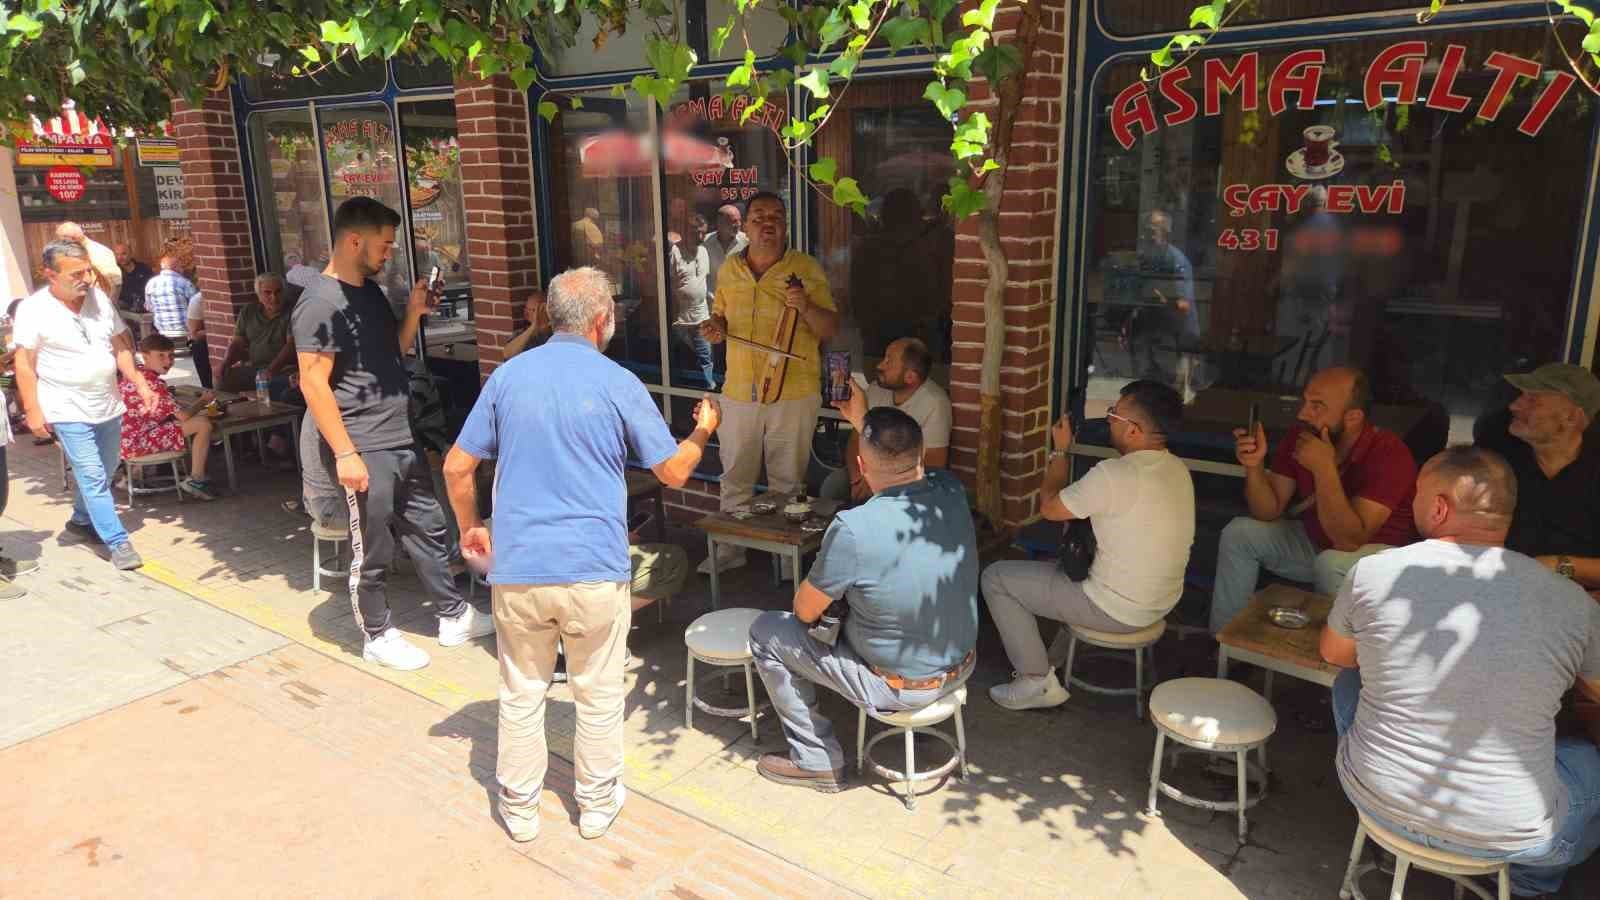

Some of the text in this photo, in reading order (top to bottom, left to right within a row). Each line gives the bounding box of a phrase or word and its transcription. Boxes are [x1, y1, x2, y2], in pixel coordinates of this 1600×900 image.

[1110, 41, 1576, 150] ASMA ALTI
[1224, 179, 1406, 216] ÇAY EVİ
[1217, 228, 1279, 251] 431
